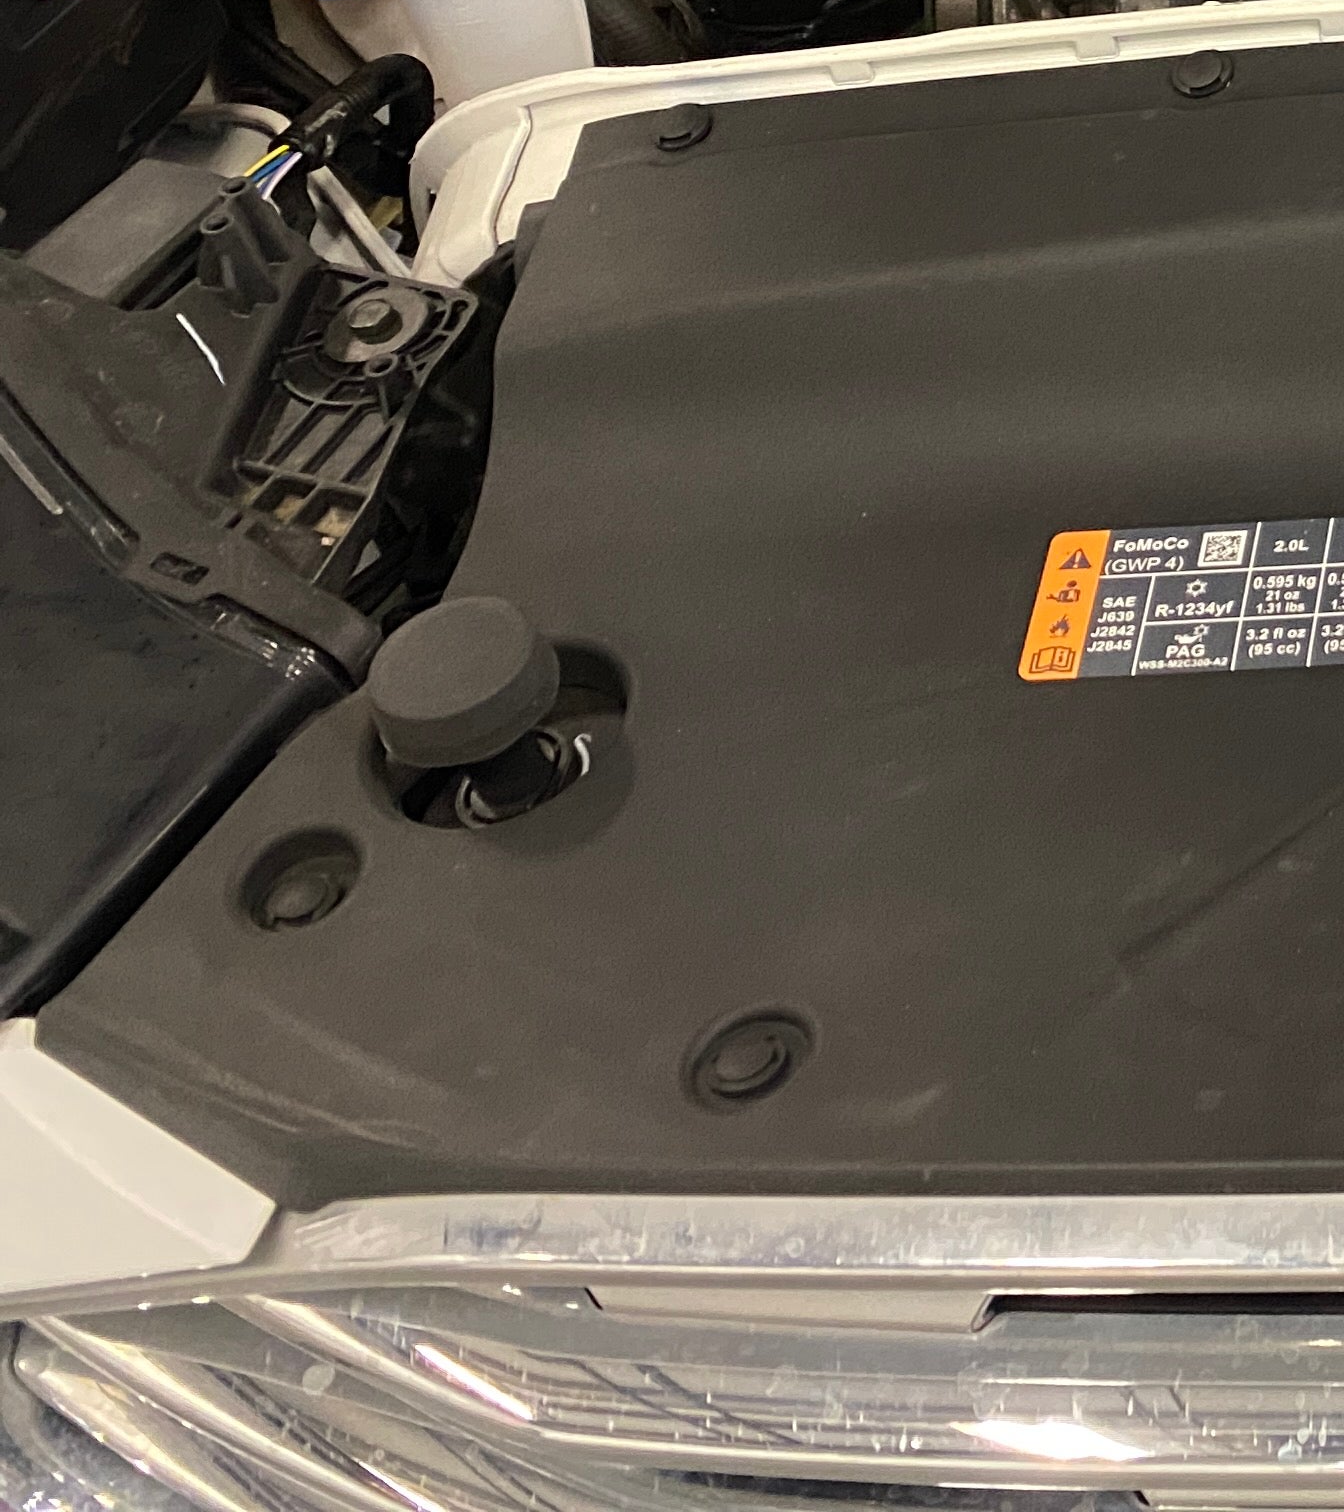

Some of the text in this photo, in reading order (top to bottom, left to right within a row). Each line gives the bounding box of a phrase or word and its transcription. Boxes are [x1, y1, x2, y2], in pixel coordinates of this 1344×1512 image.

[1113, 537, 1190, 553] FoMoCo
[1273, 539, 1310, 553] 2.0L
[1104, 555, 1185, 575] (GWP 4)
[1252, 574, 1317, 590] 0.595 kg
[1102, 596, 1137, 609] SAE
[1265, 590, 1300, 601] 21 oz
[1154, 600, 1235, 618] R-1234yf
[1255, 601, 1305, 614] 1.31 lbs
[1090, 625, 1135, 638] J2842
[1245, 627, 1307, 641] 3.2 fl oz
[1321, 624, 1344, 637] 3.2
[1086, 640, 1132, 653] J2845
[1165, 644, 1206, 659] PAG
[1248, 641, 1301, 658] (95 cc)
